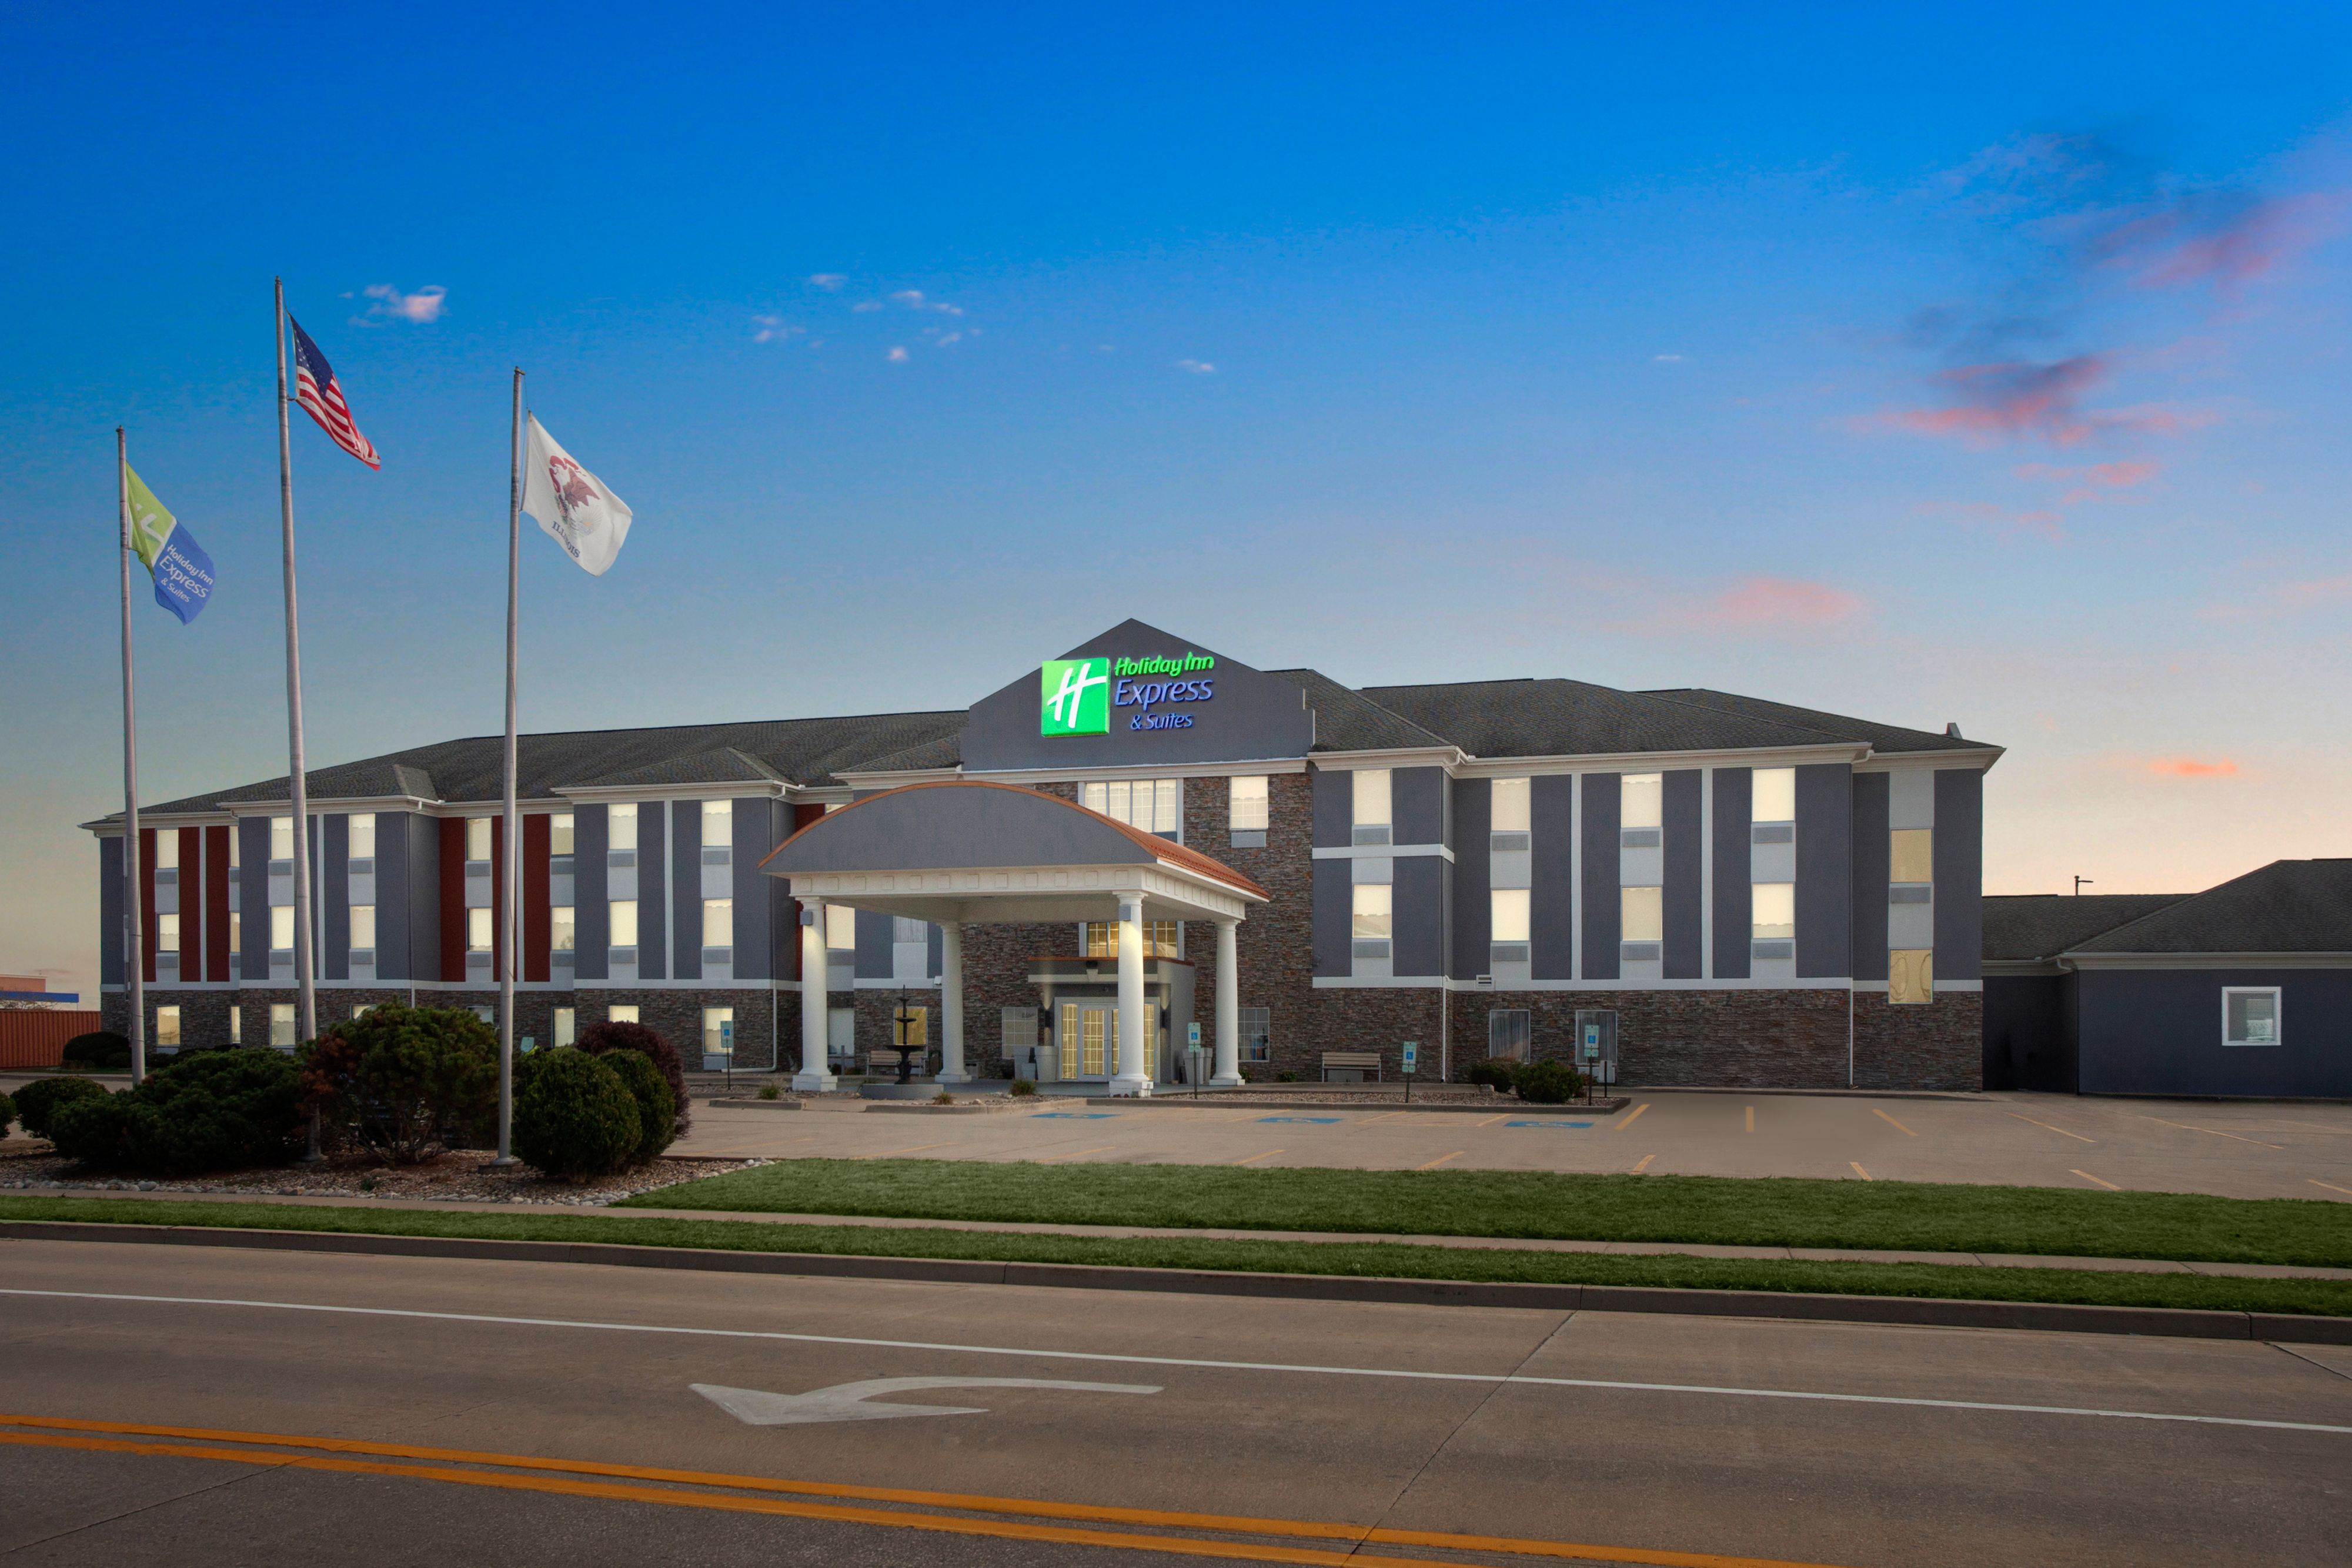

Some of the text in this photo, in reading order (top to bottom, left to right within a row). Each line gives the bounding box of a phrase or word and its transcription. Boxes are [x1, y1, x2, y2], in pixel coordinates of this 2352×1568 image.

[159, 555, 209, 598] Express
[167, 544, 214, 585] Holiday Inn
[161, 578, 191, 603] & Suites
[1115, 651, 1215, 677] Holiday Inn
[1114, 678, 1214, 711] Express
[1130, 713, 1194, 730] & Suites
